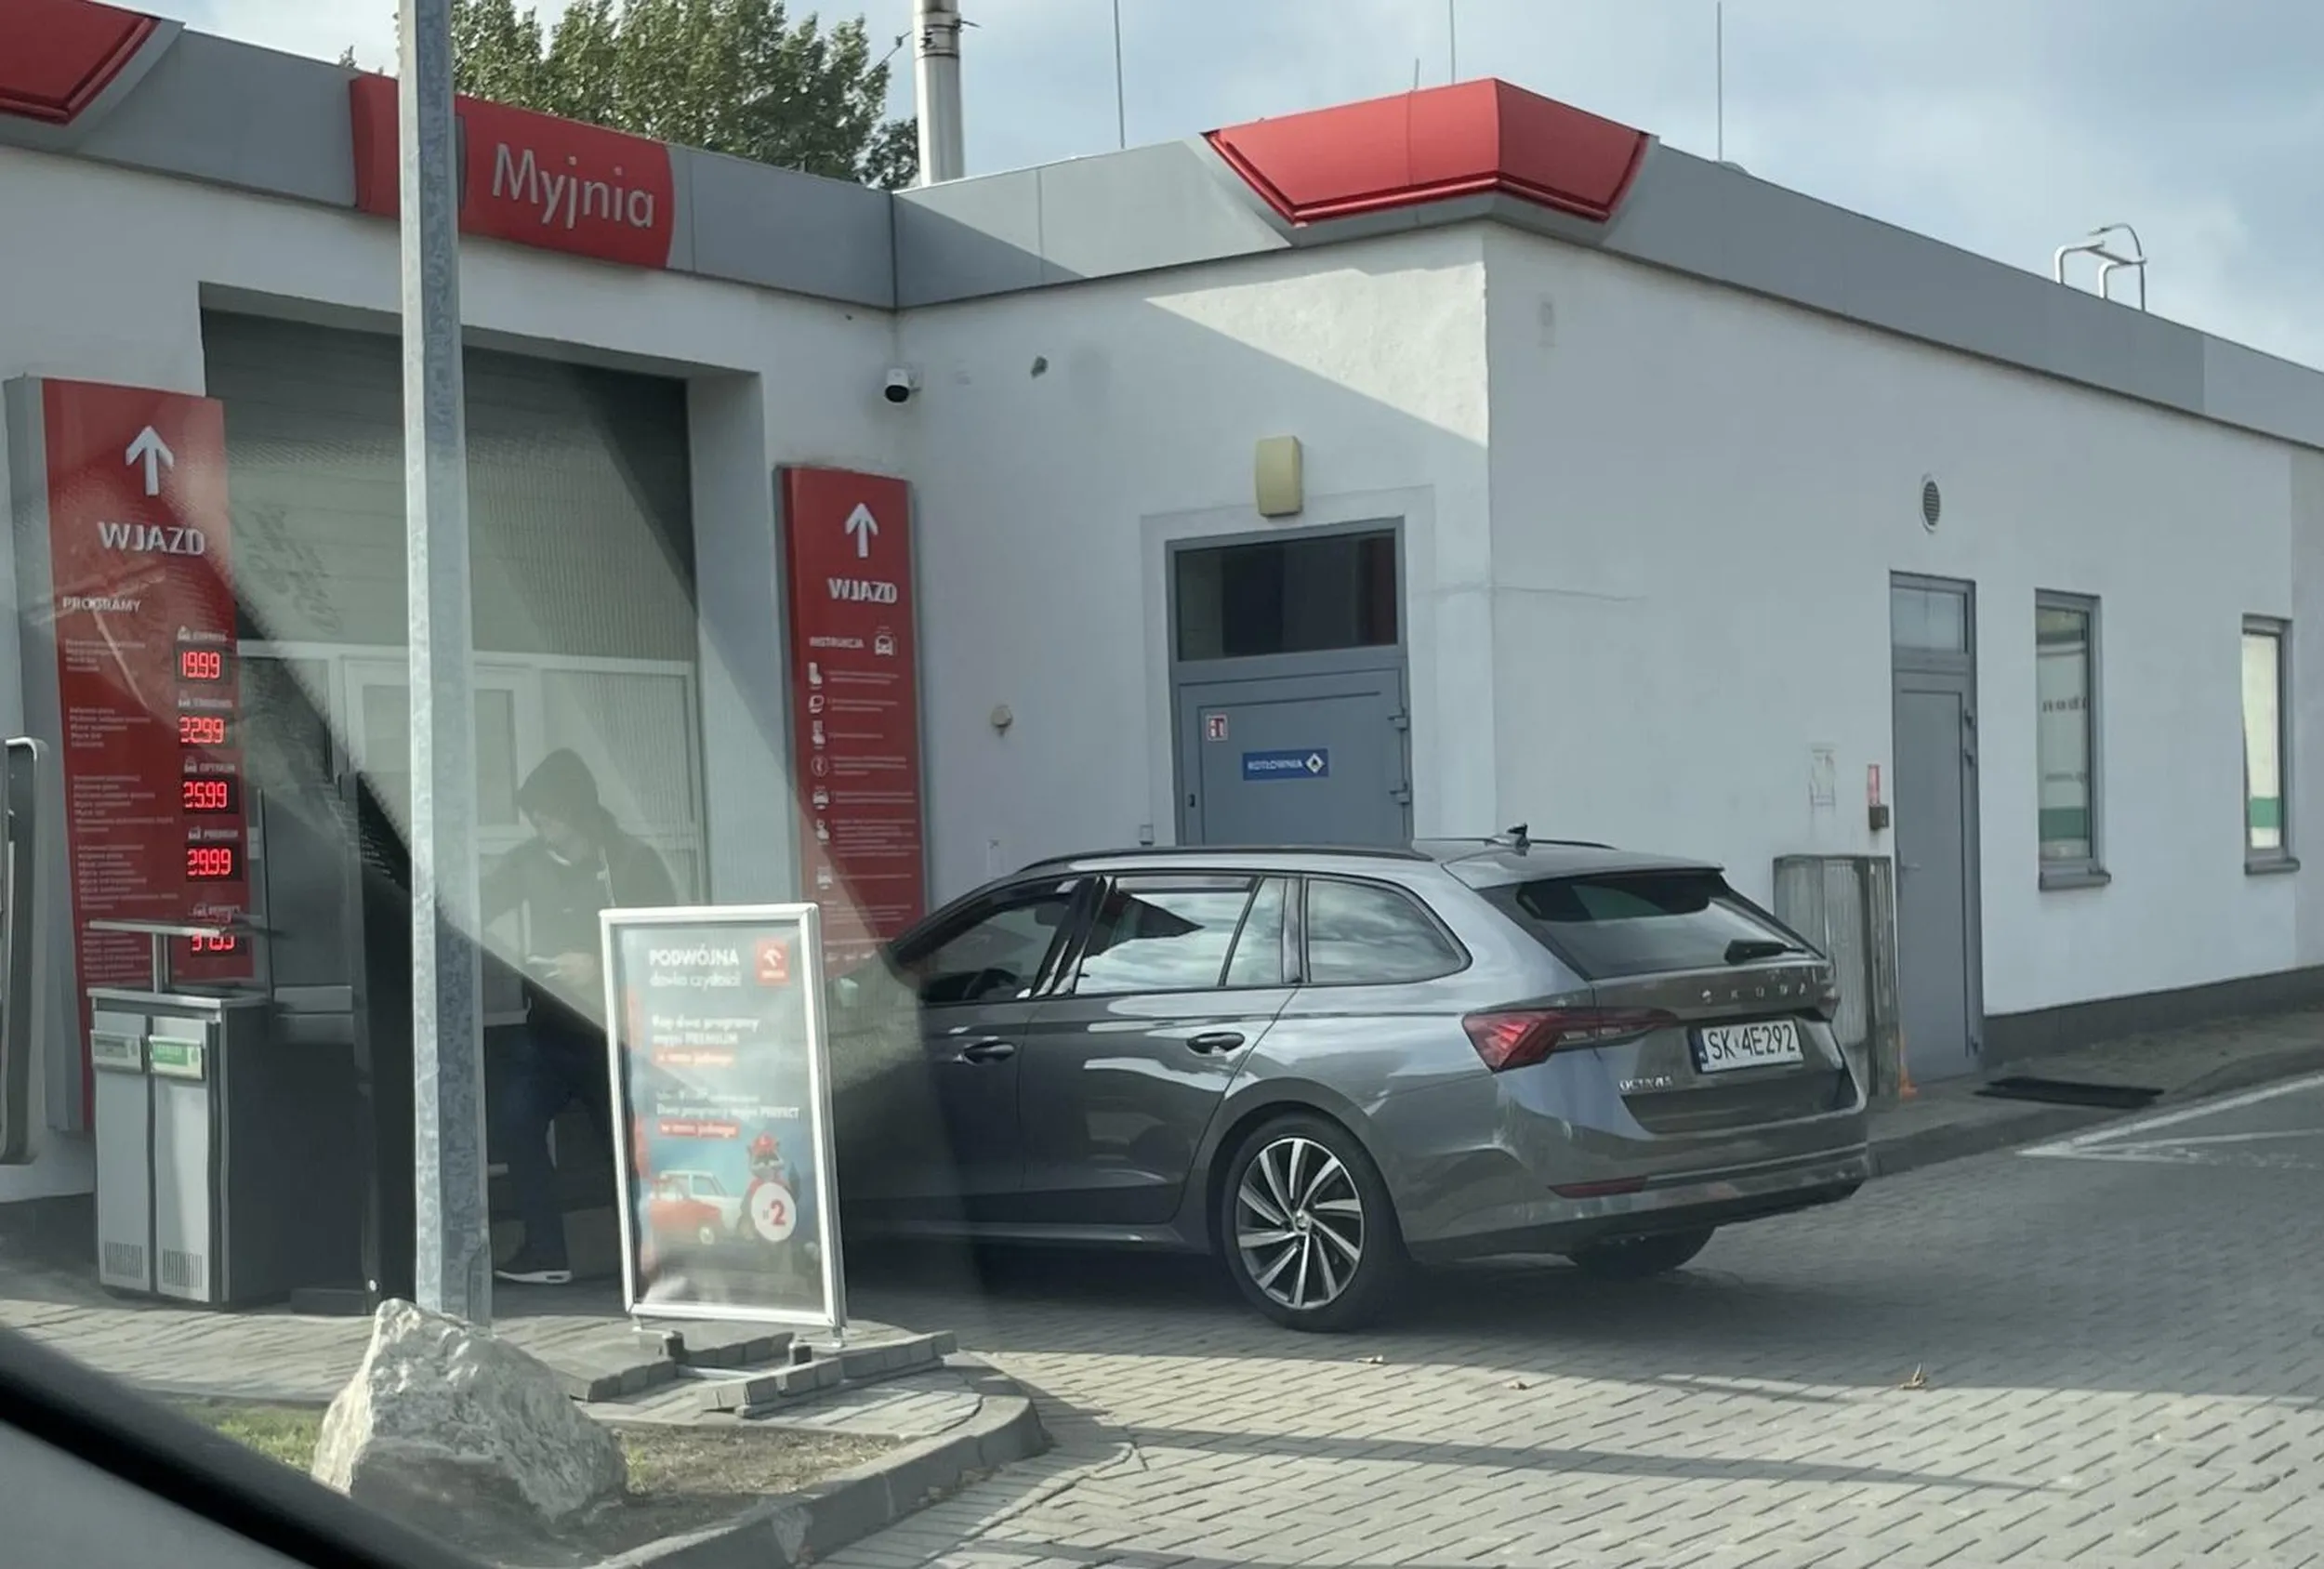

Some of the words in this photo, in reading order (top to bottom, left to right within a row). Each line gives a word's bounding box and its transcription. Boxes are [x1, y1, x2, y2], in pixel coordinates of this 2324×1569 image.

[493, 143, 654, 229] Myjnia
[97, 521, 205, 555] WJAZD
[827, 577, 898, 603] WJAZD
[1708, 1028, 1736, 1061] SK
[1741, 1024, 1796, 1056] 4E292
